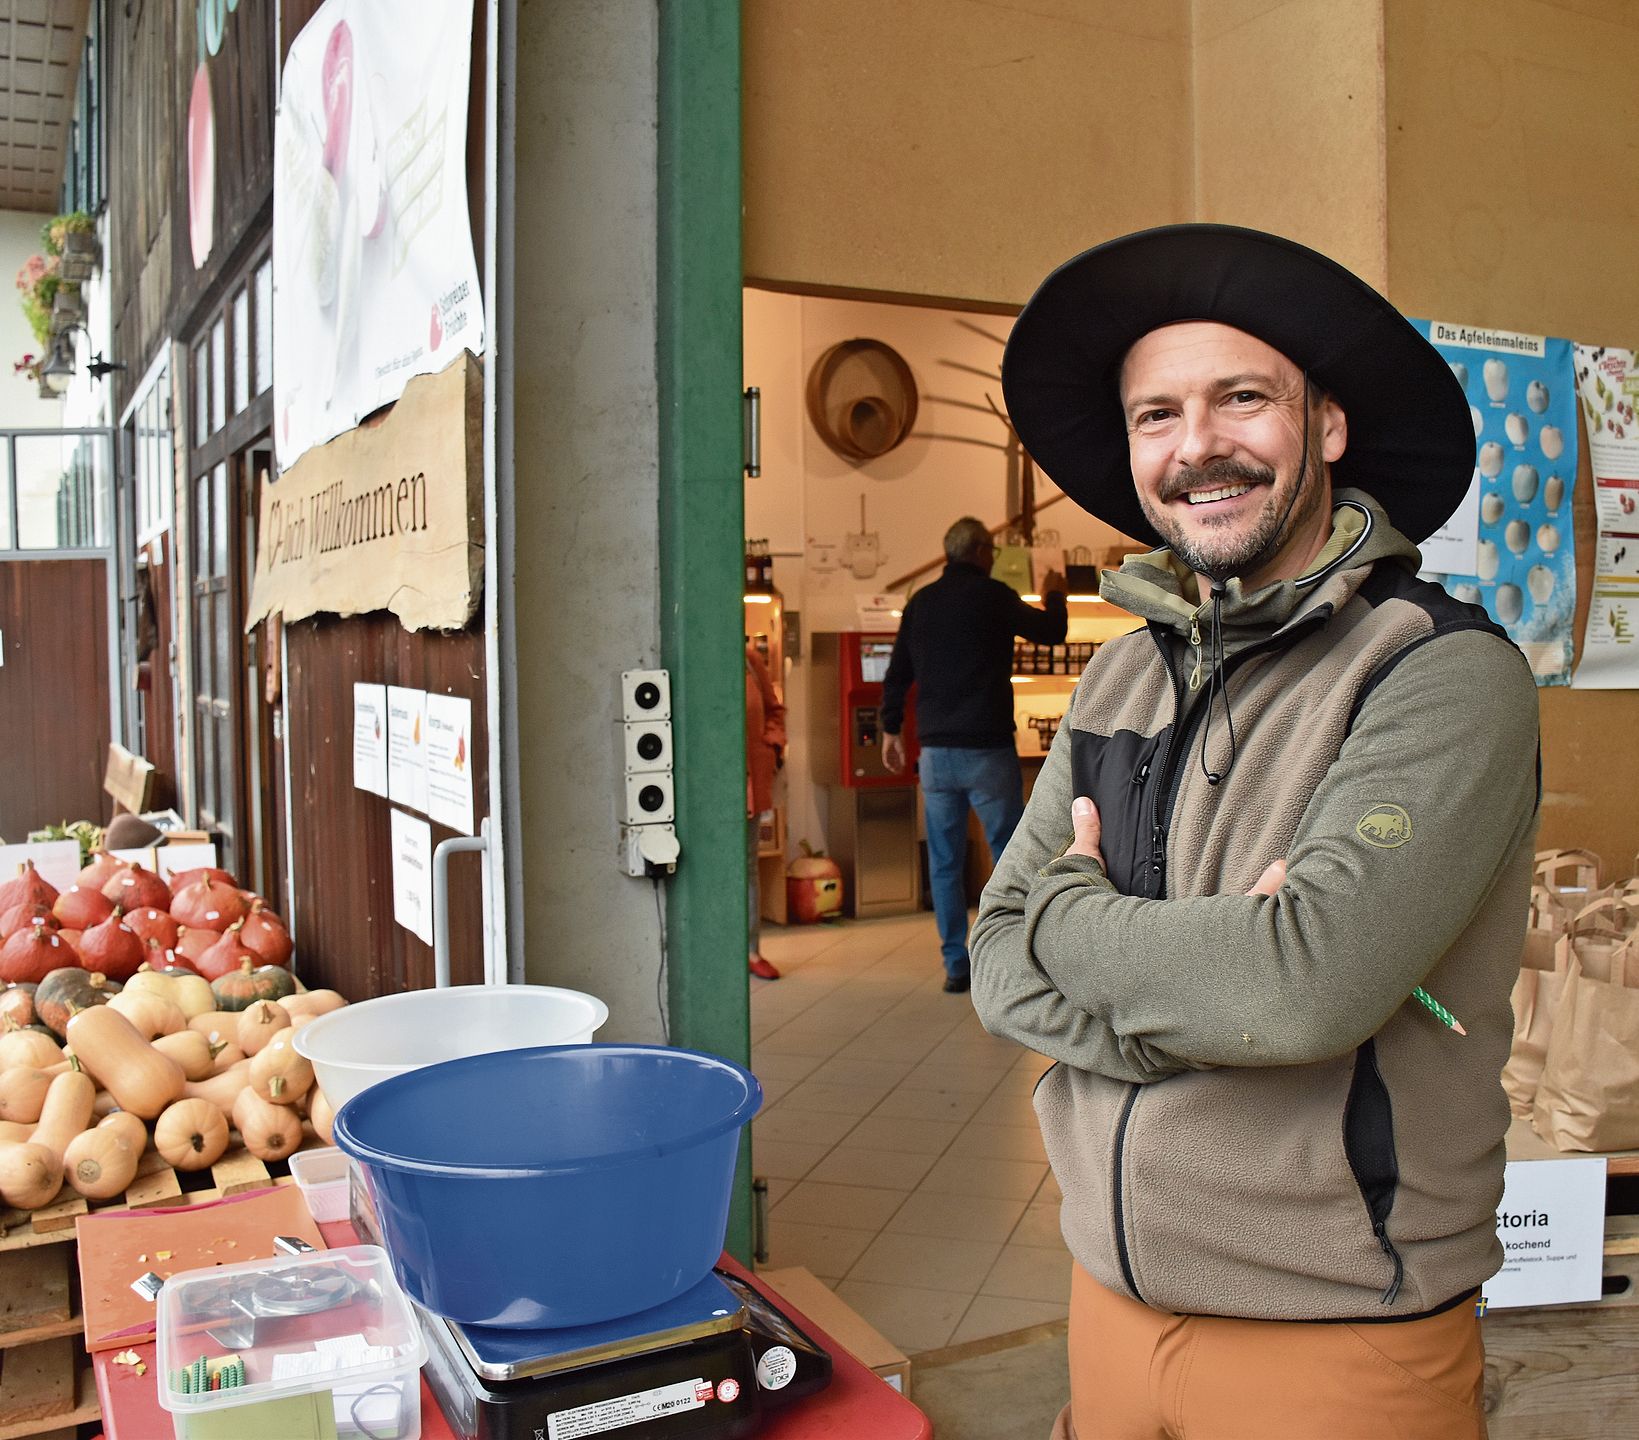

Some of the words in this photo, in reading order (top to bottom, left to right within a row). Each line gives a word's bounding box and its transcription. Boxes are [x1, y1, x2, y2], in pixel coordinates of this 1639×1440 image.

[1437, 326, 1456, 340] Das
[1460, 329, 1539, 352] Apfeleinmaleins
[310, 472, 427, 556] Willkommen
[1505, 1239, 1551, 1250] kochend
[770, 1366, 784, 1376] 2022
